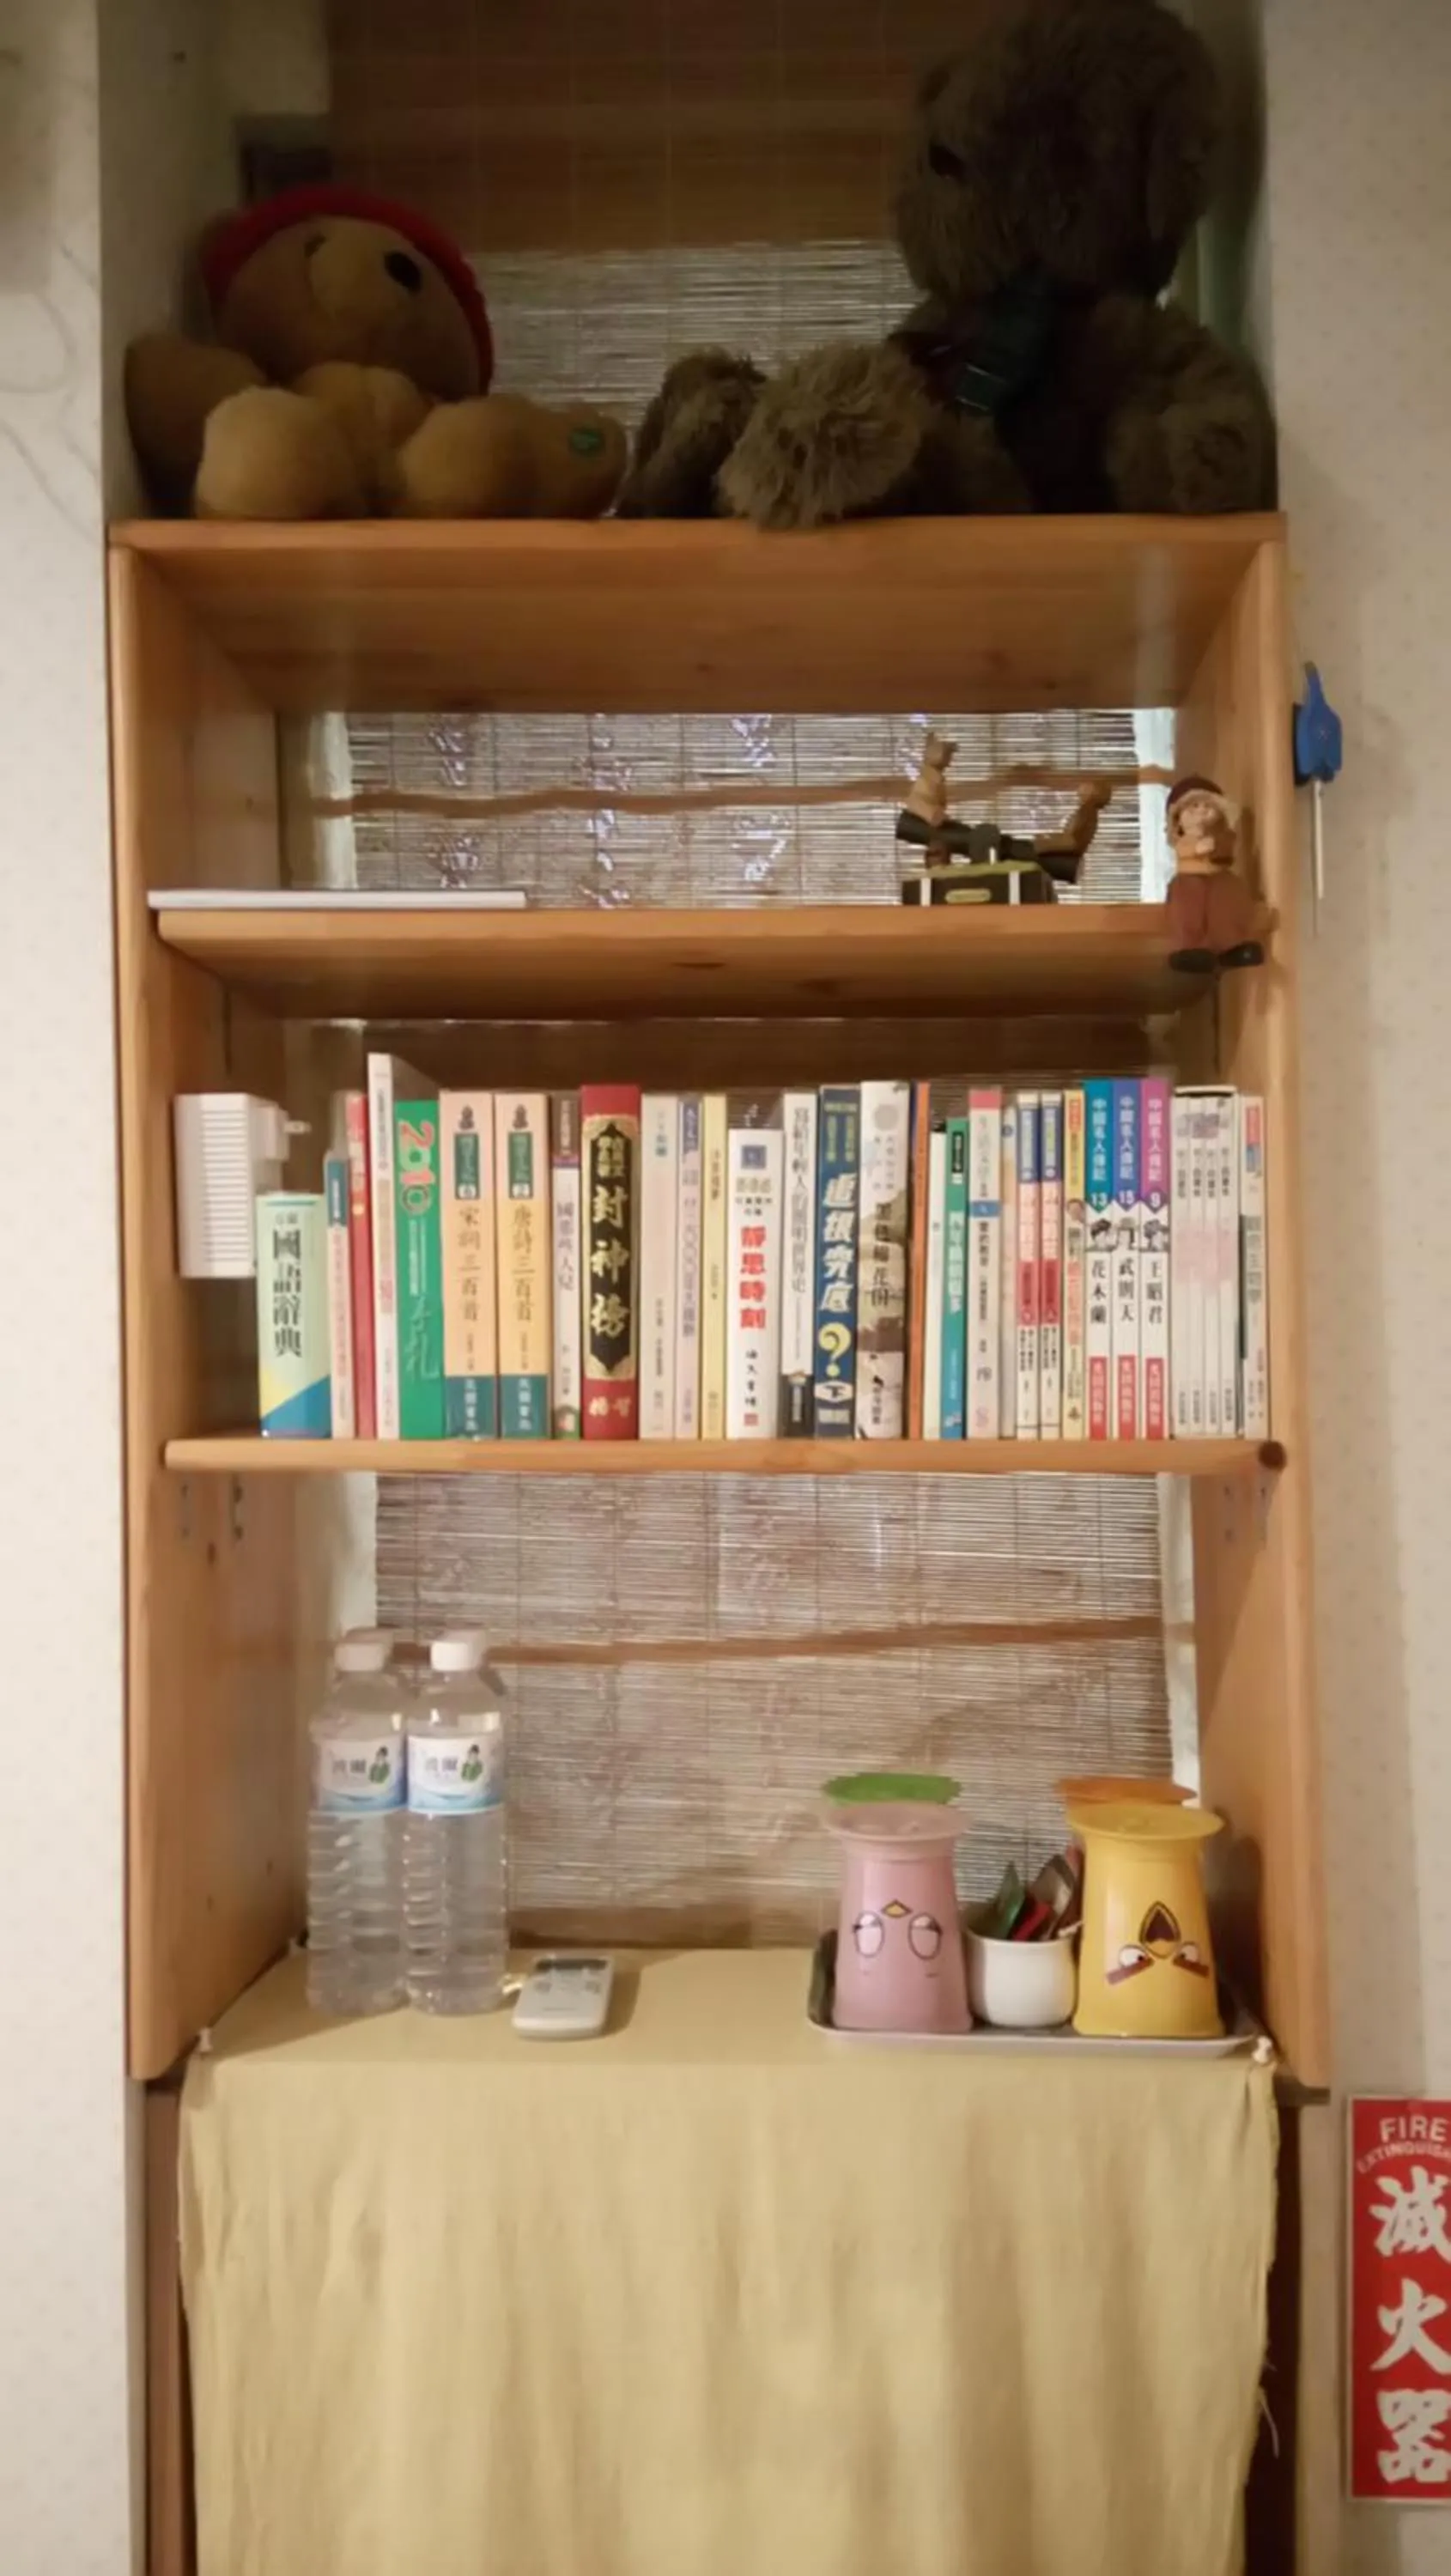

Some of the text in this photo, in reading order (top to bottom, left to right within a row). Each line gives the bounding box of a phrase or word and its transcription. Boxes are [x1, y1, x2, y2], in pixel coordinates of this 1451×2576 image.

[398, 1119, 435, 1216] 2010
[1091, 1192, 1108, 1206] 13
[273, 1229, 301, 1358] 國語辭典
[458, 1205, 481, 1322] 宋詞三百首
[513, 1204, 536, 1322] 唐詩三百首
[590, 1184, 631, 1340] 封神榜
[739, 1226, 768, 1329] 靜思時刻
[1090, 1260, 1107, 1324] 花木蘭
[1119, 1257, 1135, 1322] 武則天
[1146, 1261, 1163, 1324] 王昭君
[1380, 2113, 1448, 2143] FIRE
[1369, 2165, 1451, 2484] 滅火器
